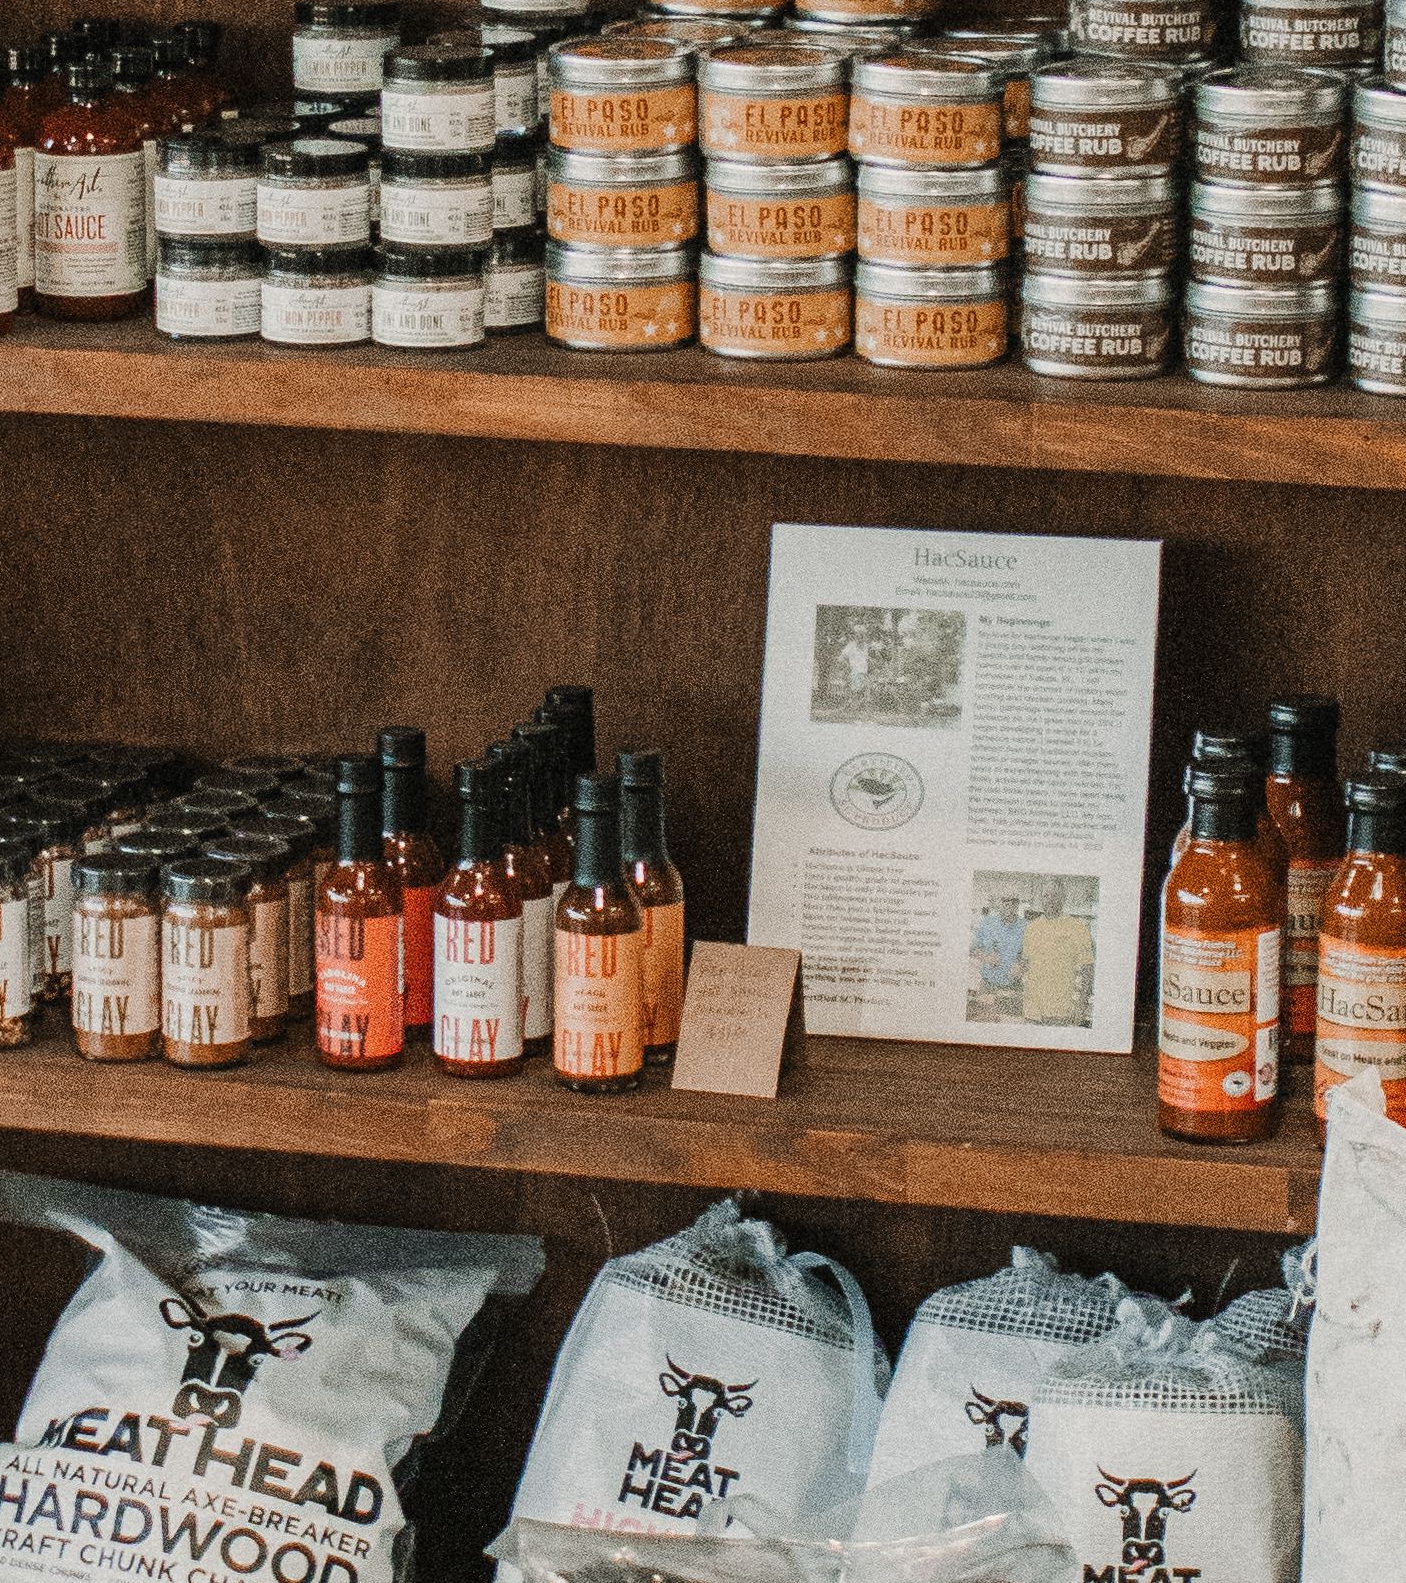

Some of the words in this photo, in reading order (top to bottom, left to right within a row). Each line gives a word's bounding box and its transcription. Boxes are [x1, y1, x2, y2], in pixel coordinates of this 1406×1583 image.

[1139, 9, 1200, 27] BUTCHERY
[1298, 16, 1360, 32] BUTCHERY
[1087, 24, 1163, 45] COFFEE
[1167, 25, 1201, 44] RUB
[1248, 30, 1315, 50] COFFEE
[1320, 31, 1361, 49] RUB
[586, 97, 650, 123] PASO
[899, 109, 964, 134] PASO
[1239, 137, 1301, 153] BUTCHERY
[1196, 151, 1258, 171] COFFEE
[1262, 154, 1302, 172] RUB
[596, 193, 662, 220] PASO
[53, 214, 107, 241] SAUCE
[632, 218, 661, 233] RUB
[914, 309, 979, 334] PASO
[1080, 322, 1143, 338] BUTCHERY
[947, 334, 979, 350] RUB
[1031, 334, 1096, 355] COFFEE
[1099, 336, 1143, 354] RUB
[912, 546, 1019, 571] HacSauce
[444, 919, 496, 965] RED
[566, 933, 618, 979] RED
[439, 1013, 501, 1062] CLAY
[560, 1028, 624, 1077] CLAY
[225, 1280, 278, 1295] YOUR
[194, 1420, 385, 1526] HEAD
[627, 1439, 742, 1500] MEAT
[6, 1454, 46, 1478] ALL
[53, 1459, 173, 1502] NATURAL
[180, 1486, 374, 1560] AXE-BREAKER
[616, 1472, 711, 1520] HEA
[78, 1542, 180, 1583] CHUNK
